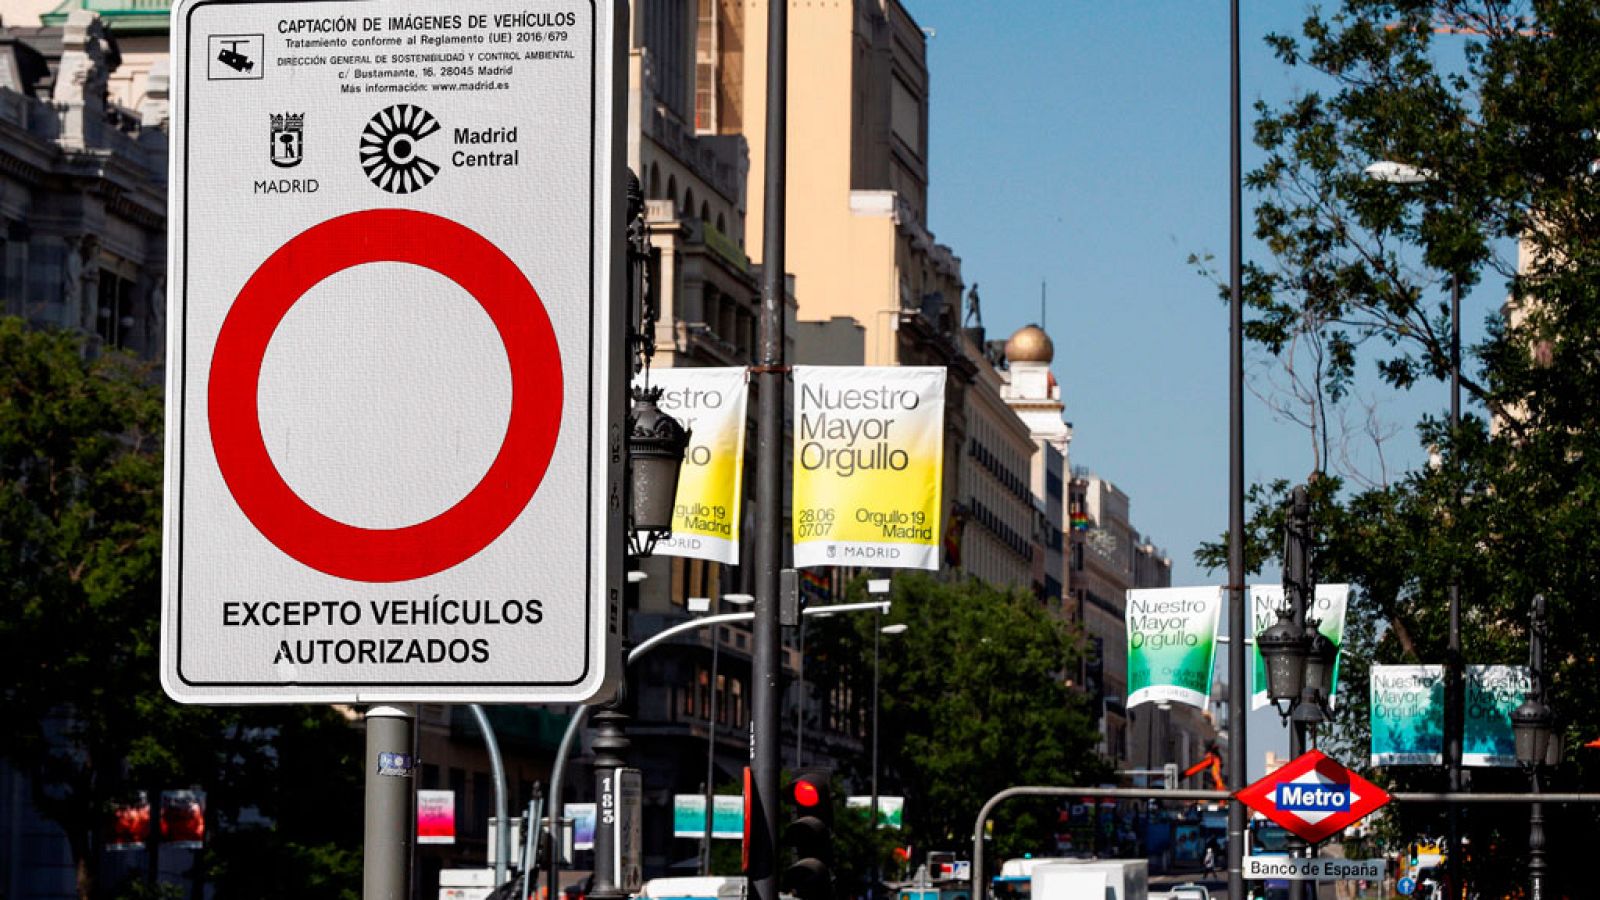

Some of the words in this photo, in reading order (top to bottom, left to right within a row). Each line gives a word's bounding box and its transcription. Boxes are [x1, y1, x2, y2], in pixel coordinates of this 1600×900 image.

[277, 15, 357, 34] CAPTACIÓN
[363, 17, 382, 32] DE
[388, 13, 462, 31] IMÁGENES
[468, 14, 487, 29] DE
[494, 10, 576, 28] VEHÍCULOS
[285, 37, 347, 48] Tratamiento
[351, 36, 402, 46] conforme
[407, 35, 416, 45] al
[420, 33, 484, 46] Reglamento
[488, 31, 512, 43] (UE)
[516, 31, 568, 42] 2016/679
[277, 55, 327, 66] DIRECCIÓN
[330, 55, 372, 64] GENERAL
[375, 54, 387, 63] DE
[391, 52, 465, 63] SOSTENIBILIDAD
[468, 53, 474, 61] Y
[477, 52, 521, 61] CONTROL
[525, 50, 575, 60] AMBIENTAL
[338, 68, 350, 79] c/
[354, 68, 418, 79] Bustamante,
[440, 66, 474, 76] 28045
[477, 65, 513, 75] Madrid
[340, 83, 361, 93] Más
[365, 82, 428, 92] información:
[432, 80, 510, 91] www.madrid.es
[454, 126, 518, 144] Madrid
[451, 149, 519, 167] Central
[253, 179, 320, 194] MADRID
[800, 383, 920, 410] Nuestro
[800, 412, 894, 447] Mayor
[800, 441, 909, 478] Orgullo
[713, 505, 726, 519] 19
[799, 508, 835, 524] 28.06
[855, 507, 909, 526] Orgullo
[911, 511, 925, 525] 19
[684, 515, 731, 535] Madrid
[798, 523, 833, 538] 07.07
[882, 524, 932, 540] Madrid
[844, 546, 900, 560] MADRID
[222, 601, 362, 626] EXCEPTO
[370, 593, 544, 625] VEHÍCULOS
[1130, 599, 1207, 615] Nuestro
[1130, 615, 1190, 633] Mayor
[1130, 630, 1198, 651] Orgullo
[273, 638, 490, 664] AUTORIZADOS
[1374, 689, 1420, 705] Mayor
[1282, 785, 1346, 807] Metro
[1250, 861, 1298, 876] Banco
[1301, 861, 1320, 876] de
[1324, 862, 1378, 878] España
